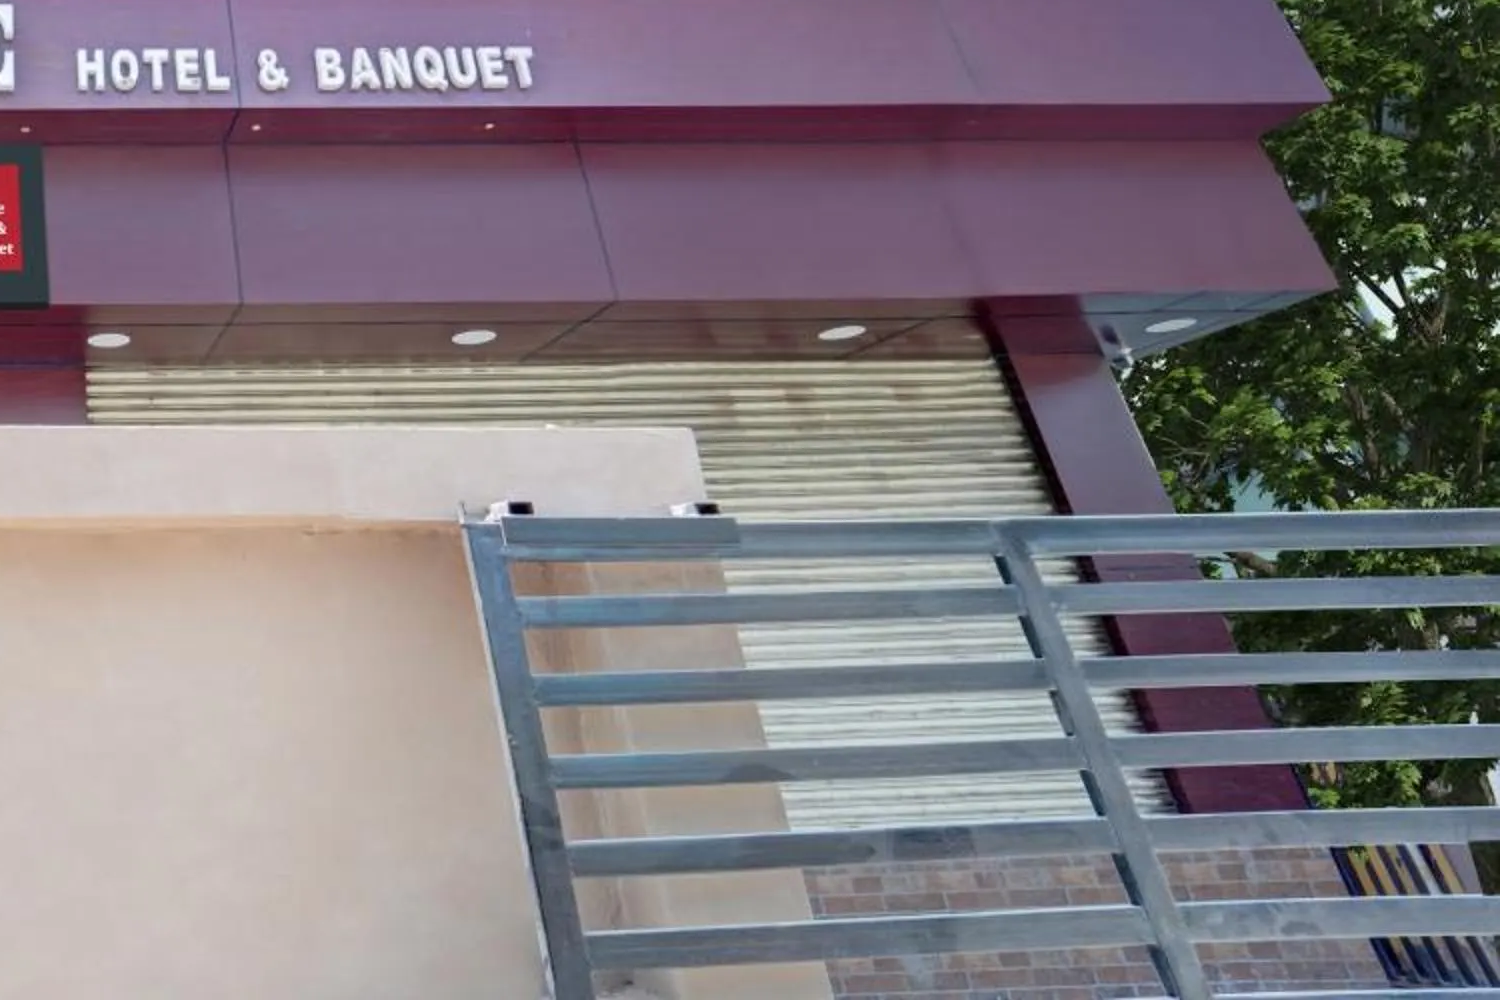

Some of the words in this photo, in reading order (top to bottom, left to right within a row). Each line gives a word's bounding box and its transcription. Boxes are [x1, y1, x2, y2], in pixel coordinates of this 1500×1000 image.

[76, 47, 231, 92] HOTEL
[257, 49, 289, 92] &
[315, 46, 534, 90] BANQUET
